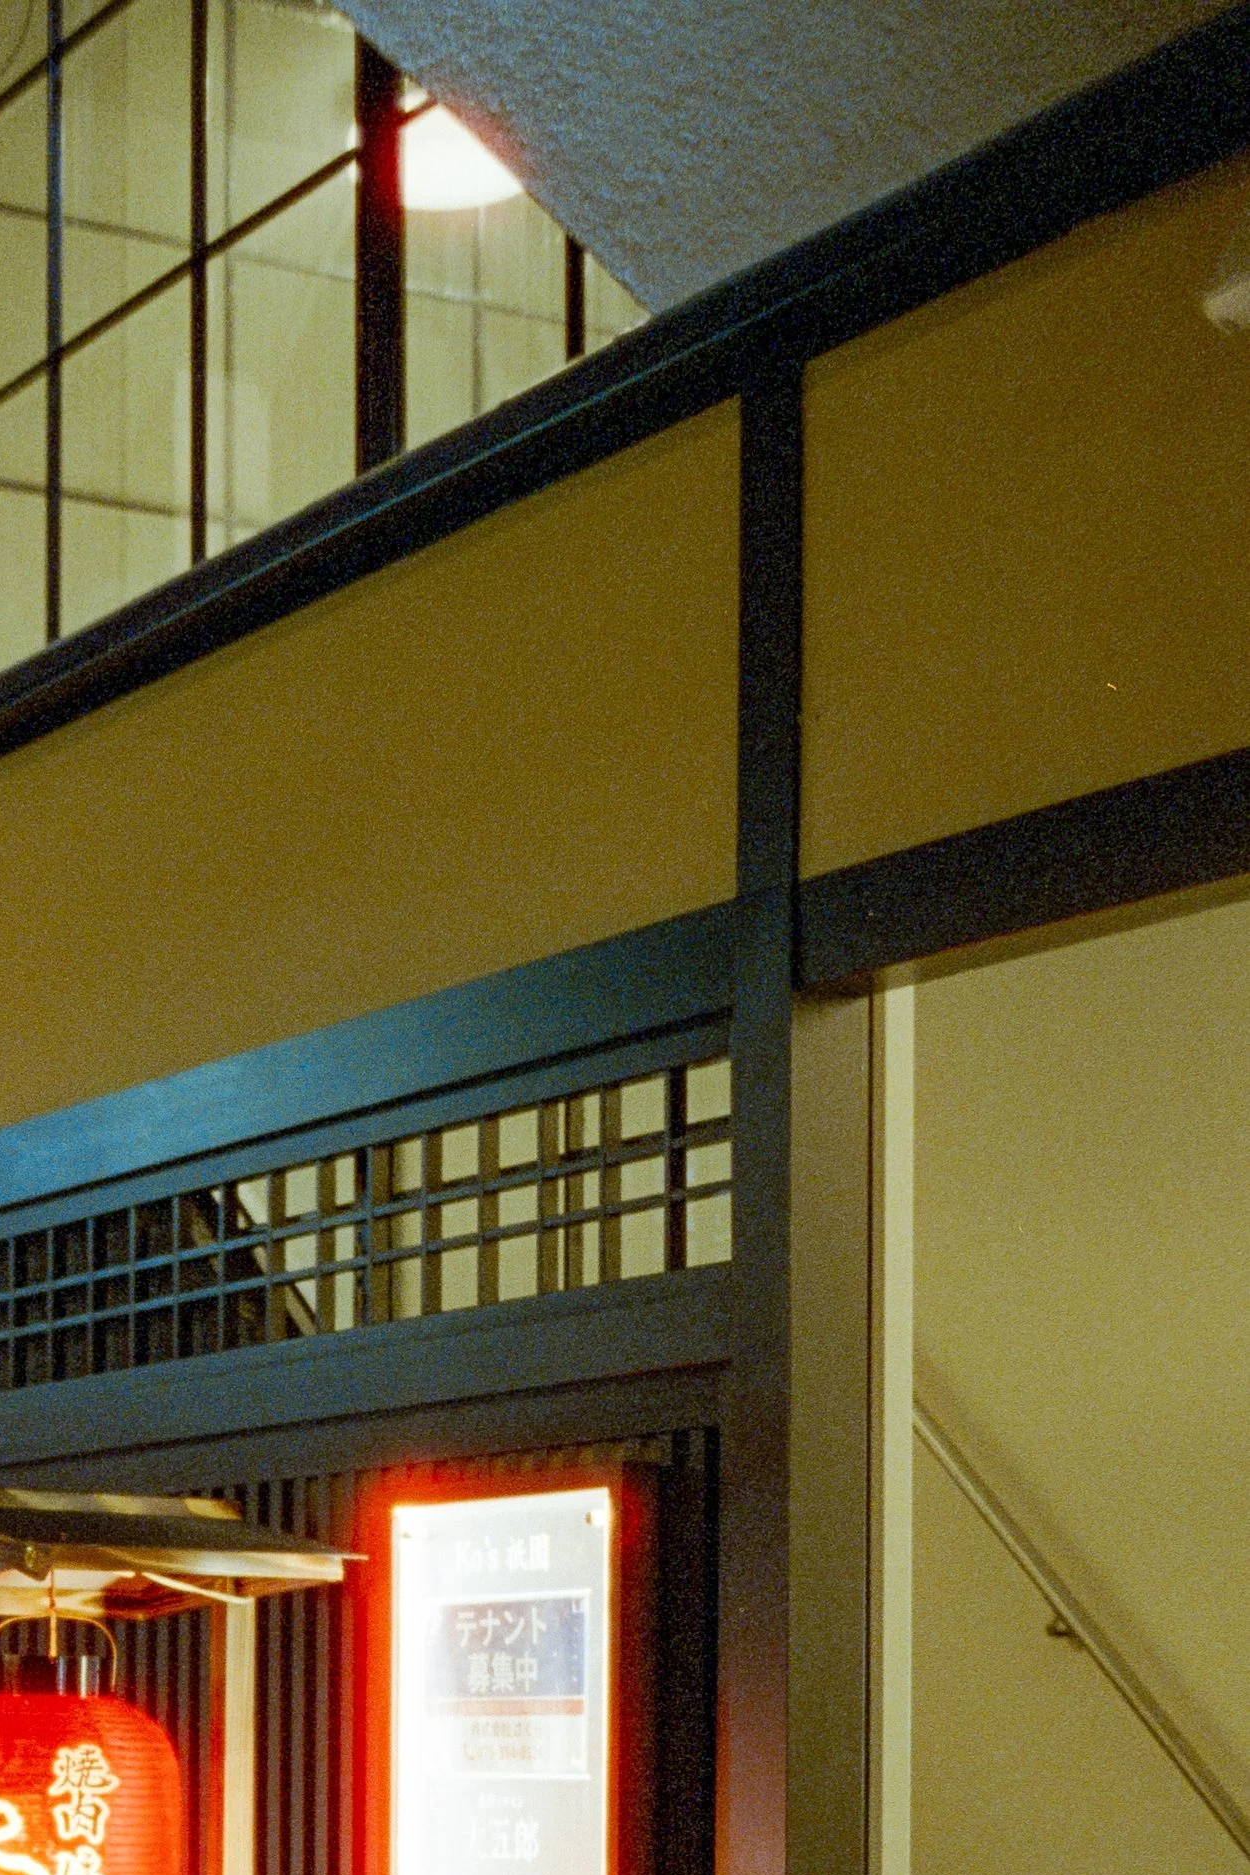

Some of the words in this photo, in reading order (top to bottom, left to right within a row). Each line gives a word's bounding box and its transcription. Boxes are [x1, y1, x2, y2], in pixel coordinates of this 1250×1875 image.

[455, 1606, 548, 1649] テナント
[466, 1650, 539, 1695] 募集中
